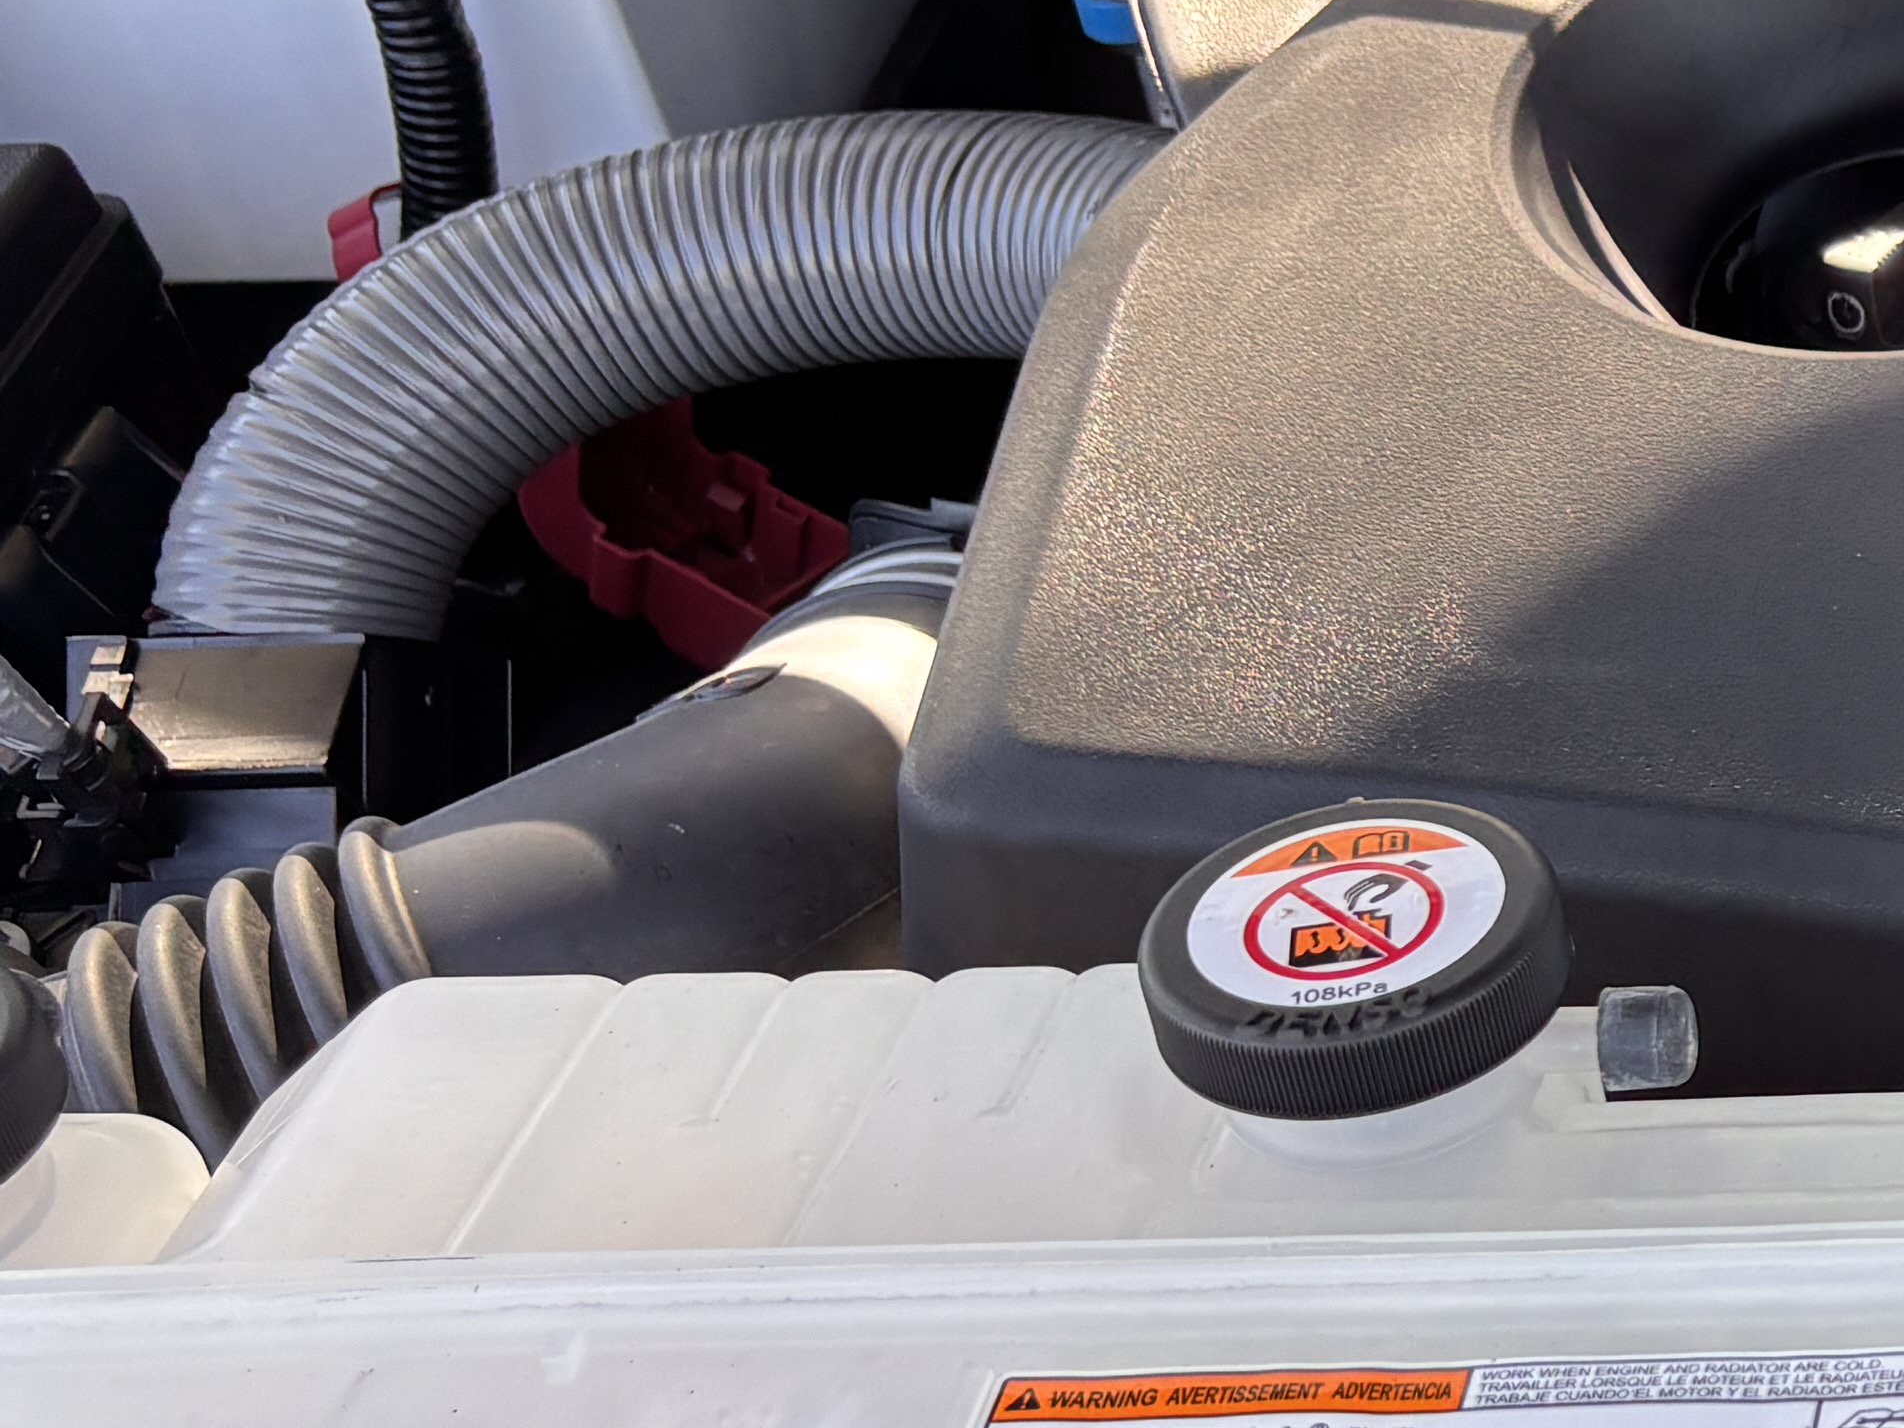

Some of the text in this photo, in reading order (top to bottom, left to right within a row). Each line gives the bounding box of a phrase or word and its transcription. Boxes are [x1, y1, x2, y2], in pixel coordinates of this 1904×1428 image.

[1290, 981, 1388, 1005] 108kPa
[1482, 1369, 1534, 1381] WORK
[1539, 1367, 1591, 1379] WHEN
[1594, 1365, 1662, 1377] ENGINE
[1664, 1364, 1701, 1375] AND
[1704, 1362, 1791, 1374] RADIATOR
[1797, 1361, 1829, 1372] ARE
[1475, 1391, 1551, 1404] TRABAJE
[1554, 1389, 1631, 1401] CUANDO
[1658, 1387, 1722, 1398] MOTOR
[1767, 1383, 1857, 1397] RADIADOR
[1479, 1378, 1577, 1392] TRAVAILLER
[1584, 1376, 1662, 1389] LORSQUE
[1692, 1374, 1765, 1385] MOTEUR
[1049, 1381, 1452, 1409] WARNING AVERTISSEMENT ADVERTENCIA
